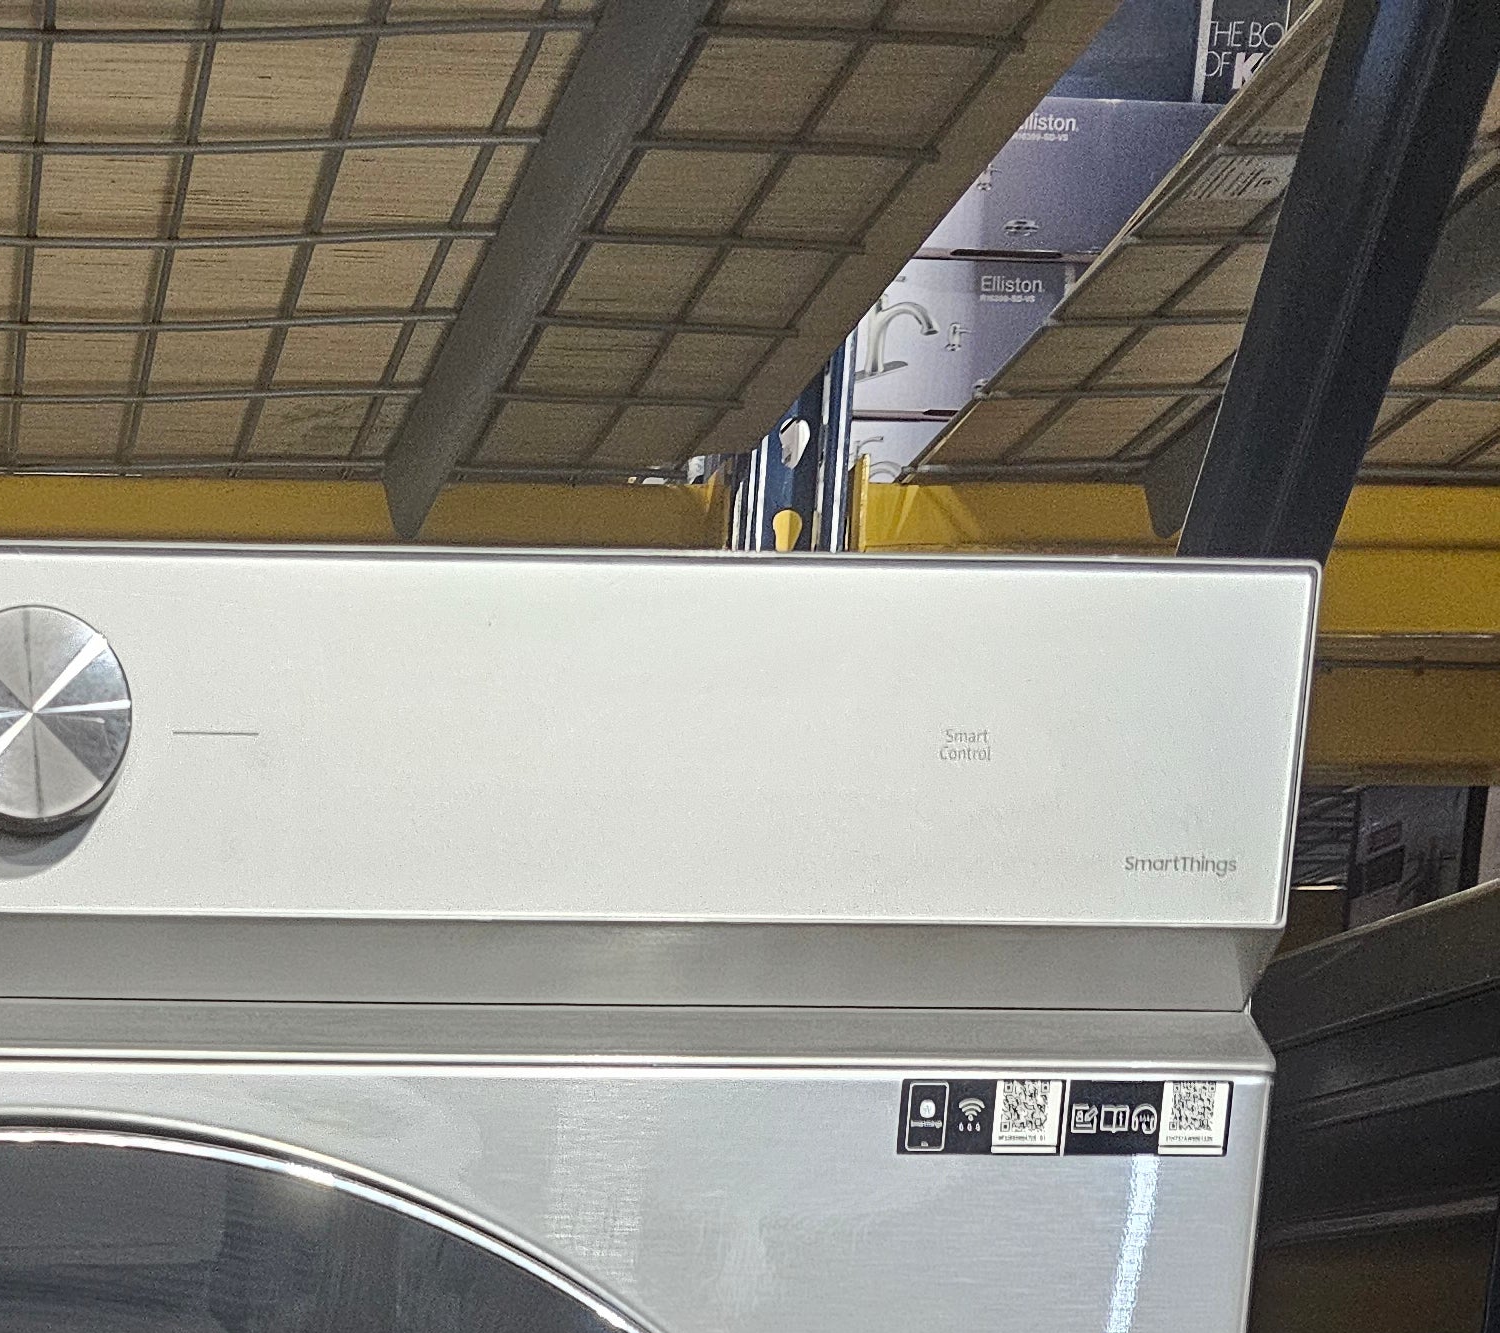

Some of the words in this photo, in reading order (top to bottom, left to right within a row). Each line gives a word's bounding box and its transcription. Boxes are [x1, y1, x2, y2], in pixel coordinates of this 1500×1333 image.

[1018, 112, 1077, 131] lliston
[981, 275, 1043, 293] Elliston
[945, 728, 988, 743] Smart
[939, 745, 991, 761] Control
[1124, 854, 1237, 877] SmartThings
